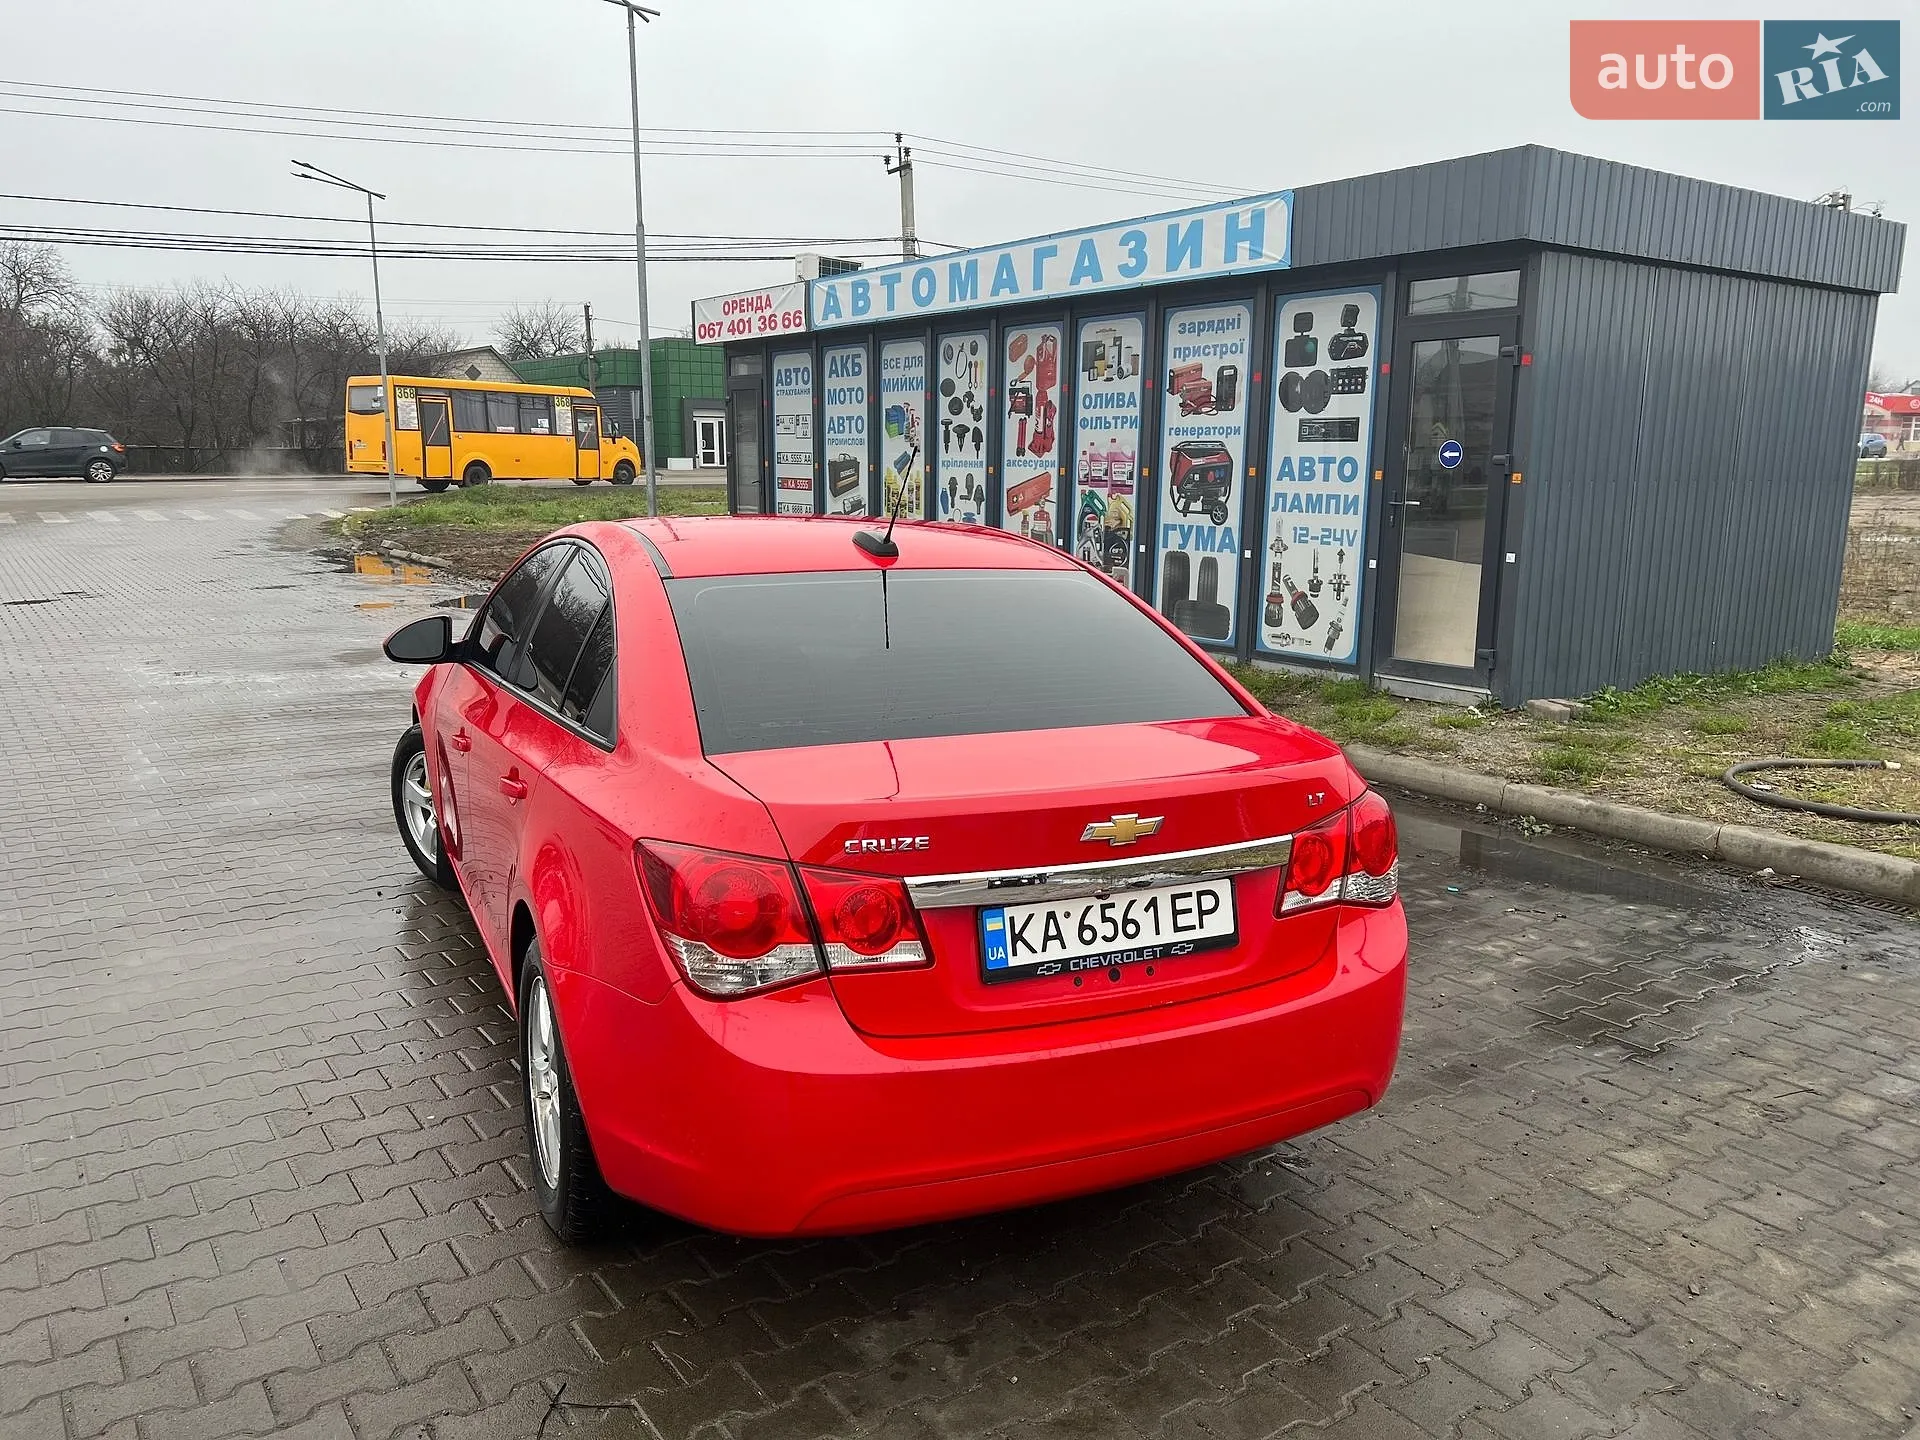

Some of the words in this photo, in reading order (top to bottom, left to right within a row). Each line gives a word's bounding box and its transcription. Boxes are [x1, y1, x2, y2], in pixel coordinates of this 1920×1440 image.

[820, 207, 1266, 322] АВТОМАГАЗИН
[722, 293, 773, 316] ОРЕНДА
[698, 321, 724, 340] 067
[727, 317, 753, 336] 401
[757, 313, 778, 333] 36
[781, 309, 803, 329] 66
[1177, 313, 1242, 337] зарядні
[1173, 338, 1246, 363] пристрої
[828, 354, 863, 379] АКБ
[883, 357, 900, 370] ВСЕ
[903, 355, 924, 371] ДЛЯ
[775, 366, 811, 387] АВТО
[882, 374, 924, 393] МИЙКИ
[397, 387, 415, 399] 368
[555, 397, 570, 408] 368
[827, 387, 865, 405] МОТО
[1082, 391, 1138, 410] ОЛИВА
[827, 415, 865, 435] АВТО
[1079, 415, 1139, 431] ФІЛЬТРИ
[1168, 424, 1242, 439] генератори
[941, 458, 984, 469] кріплення
[1006, 458, 1057, 471] аксесуари
[1276, 456, 1360, 483] АВТО
[1271, 492, 1360, 516] ЛАМПИ
[1161, 523, 1237, 554] ГУМА
[1292, 526, 1358, 548] 12-24V
[1307, 792, 1325, 807] LT
[844, 836, 930, 853] CRUZE
[1077, 896, 1161, 946] 6561
[1170, 888, 1220, 934] EP
[988, 945, 1006, 961] UA
[1069, 946, 1164, 971] CHEVROLET
